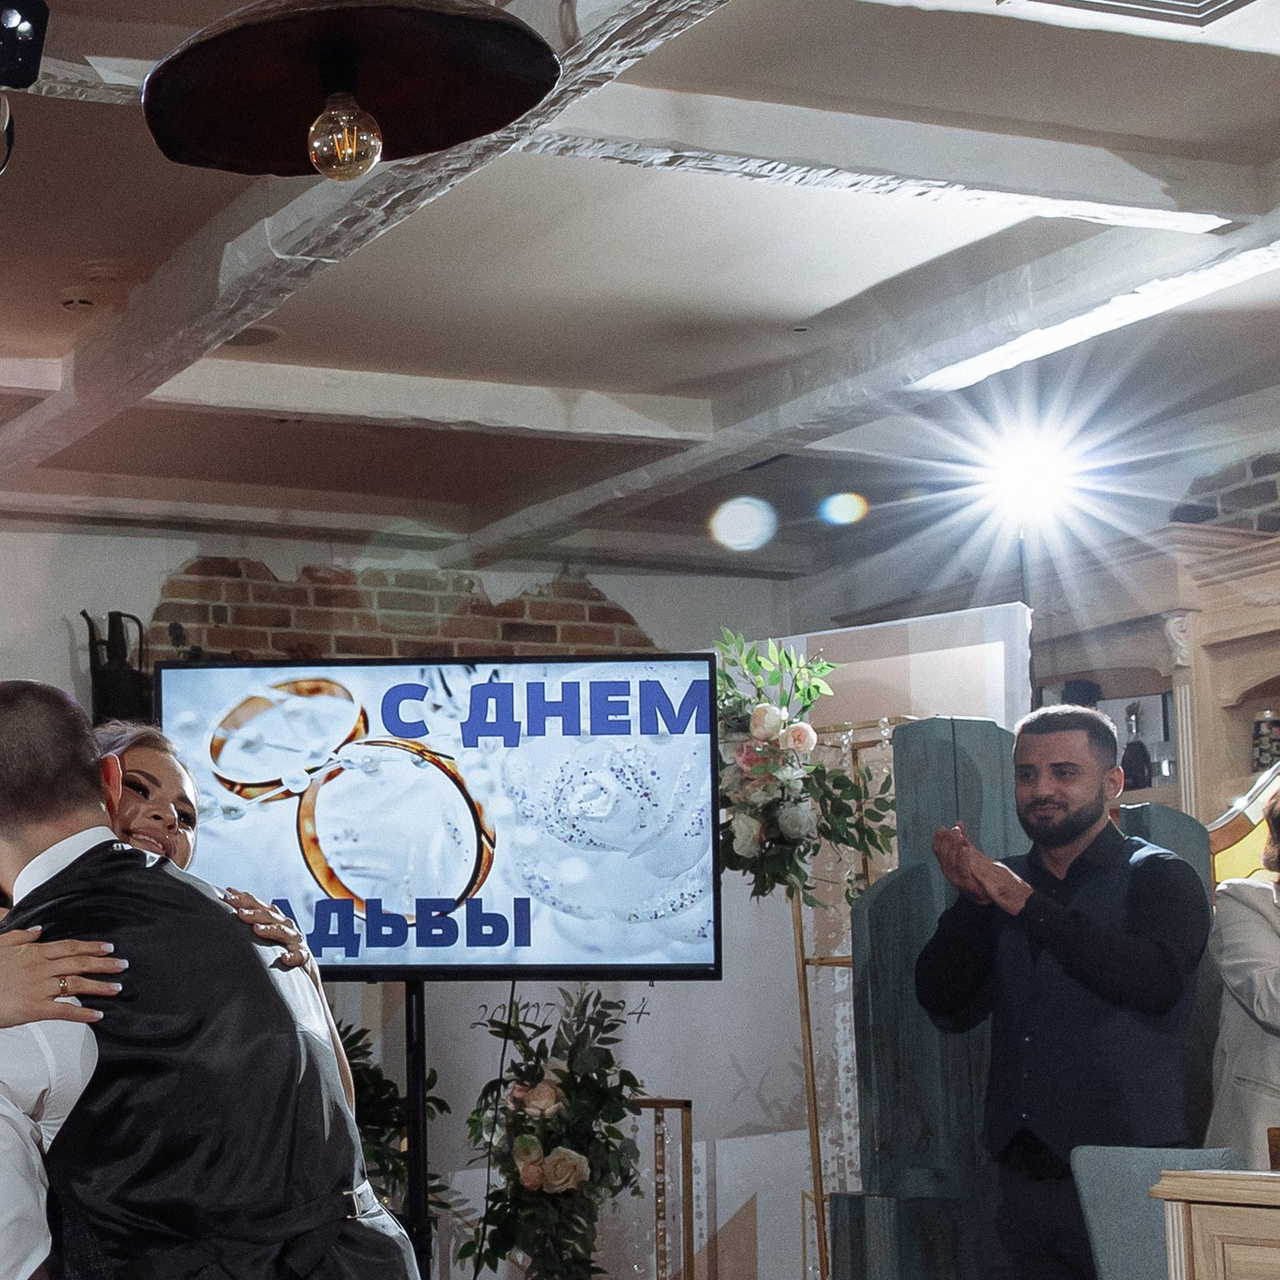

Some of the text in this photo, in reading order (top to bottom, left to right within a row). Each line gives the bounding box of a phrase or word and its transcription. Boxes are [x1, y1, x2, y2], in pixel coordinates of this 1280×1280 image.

[381, 680, 711, 748] С ДНЕМ
[271, 898, 532, 958] ДЬБЫ
